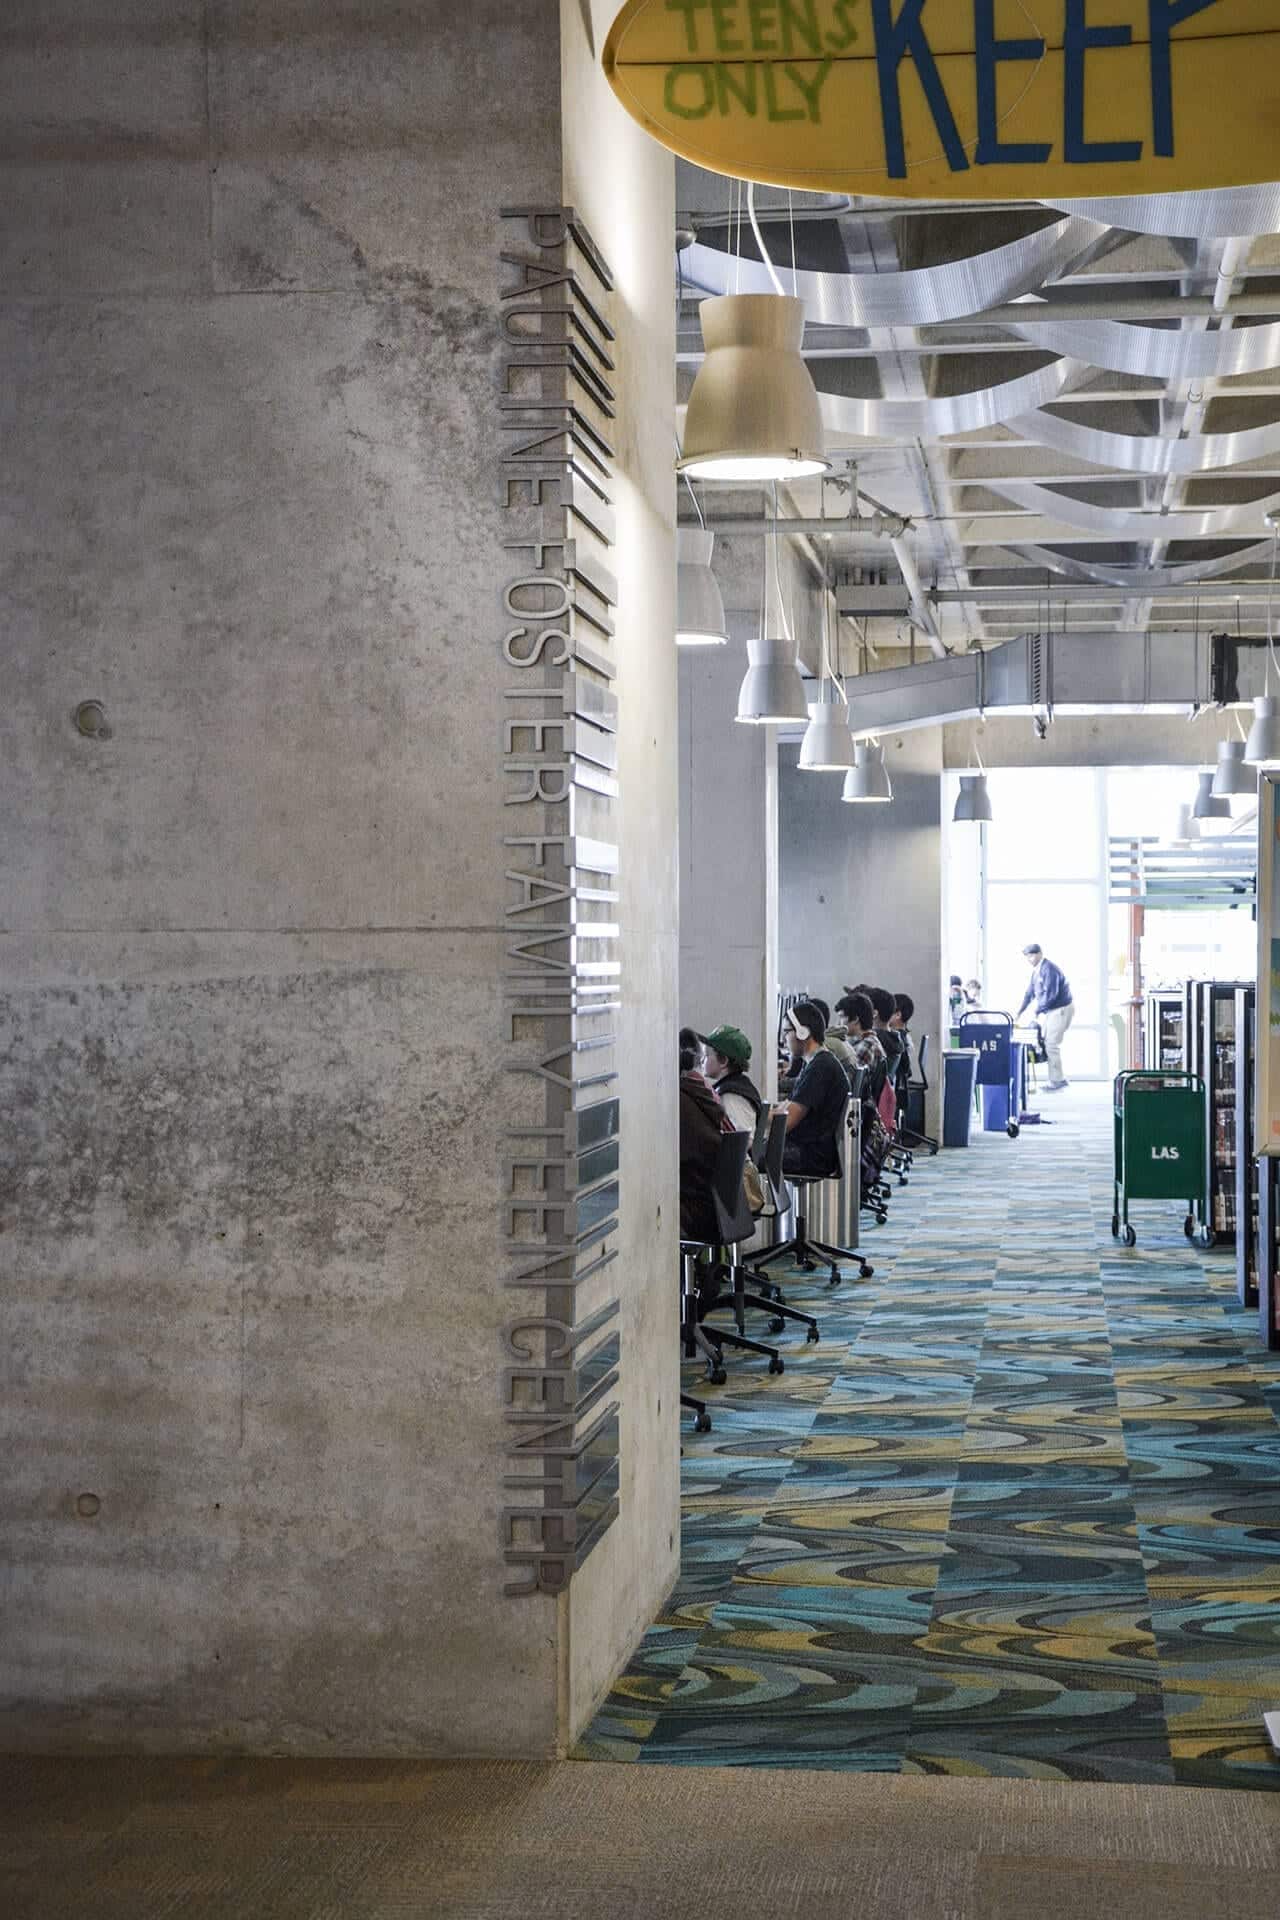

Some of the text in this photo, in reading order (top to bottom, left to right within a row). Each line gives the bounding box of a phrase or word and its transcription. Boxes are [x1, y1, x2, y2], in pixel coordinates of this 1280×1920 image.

[664, 0, 859, 54] TEENS
[663, 53, 834, 125] ONLY
[500, 206, 578, 1597] PAULINE FOSTER FAMILY TEEN CENTER
[1151, 1146, 1180, 1160] LAS
